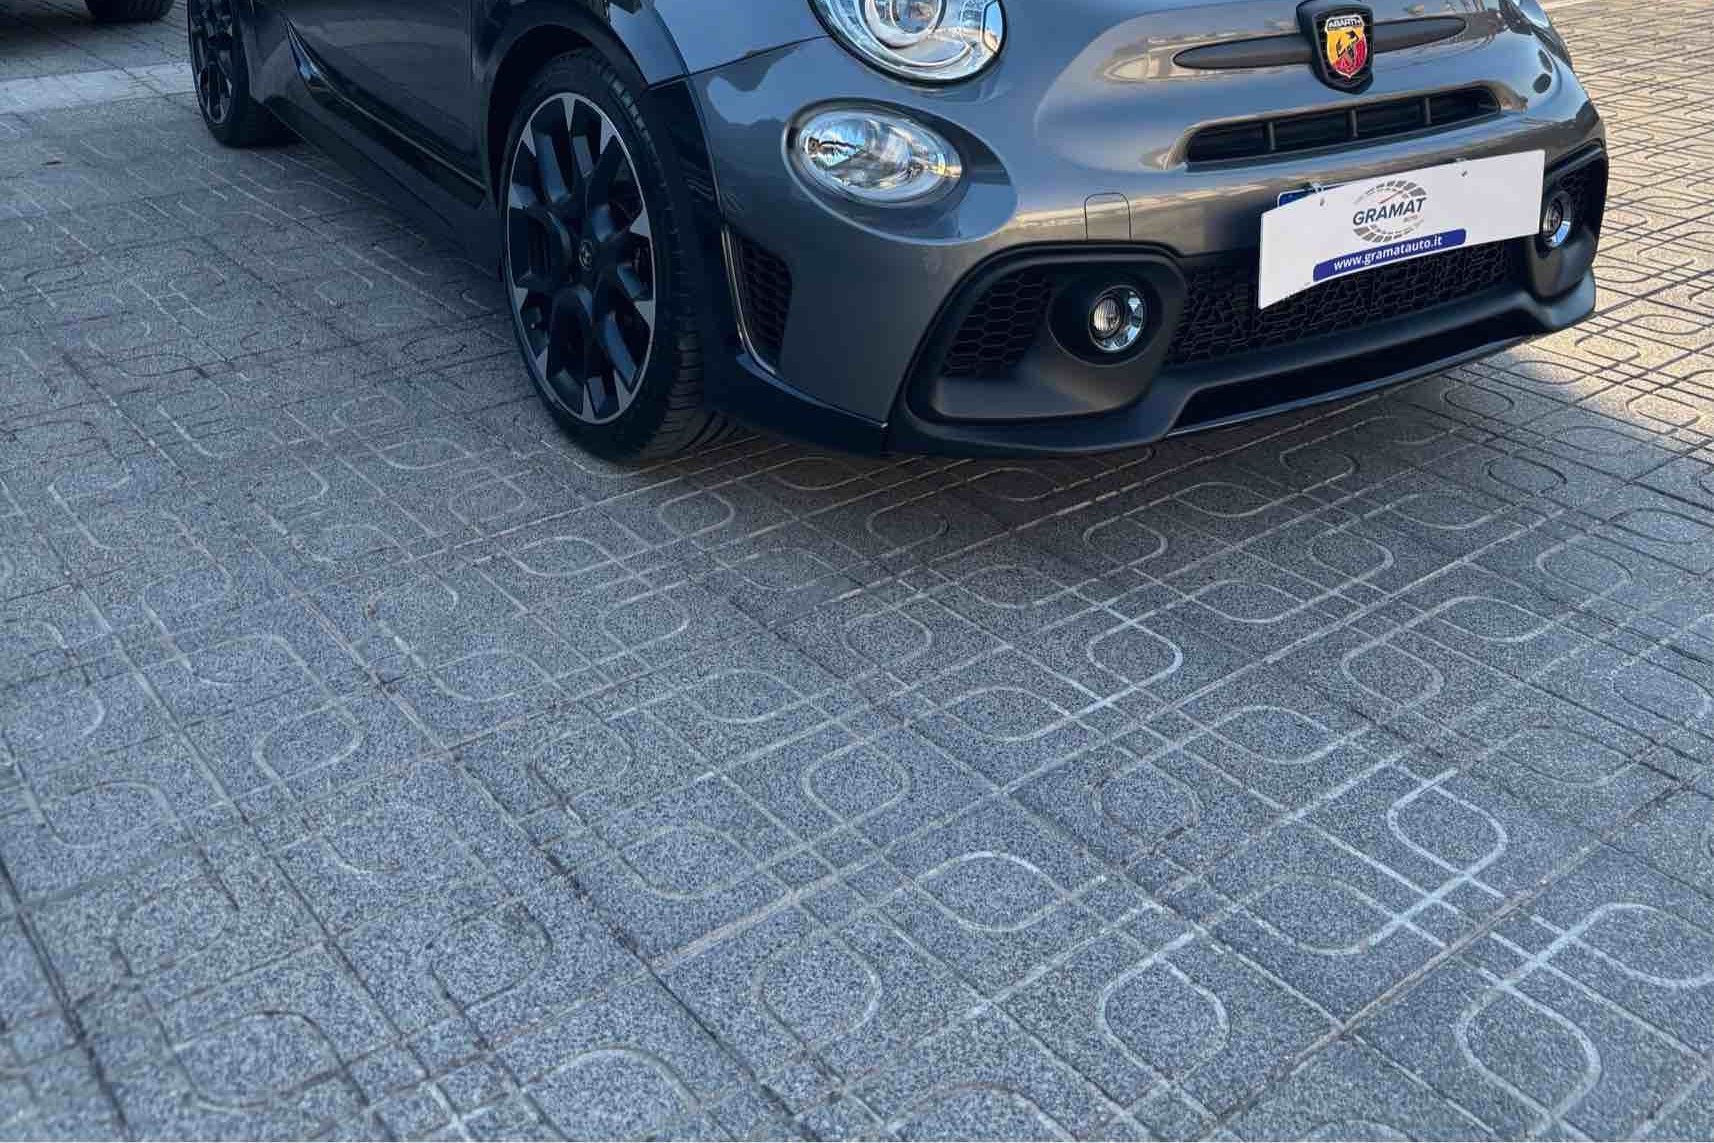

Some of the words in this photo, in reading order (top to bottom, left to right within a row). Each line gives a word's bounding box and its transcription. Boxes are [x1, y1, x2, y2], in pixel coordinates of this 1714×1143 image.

[1328, 17, 1361, 27] ABARTH
[1353, 197, 1427, 226] GRAMAT
[1333, 235, 1443, 271] www.gramatauto.it
